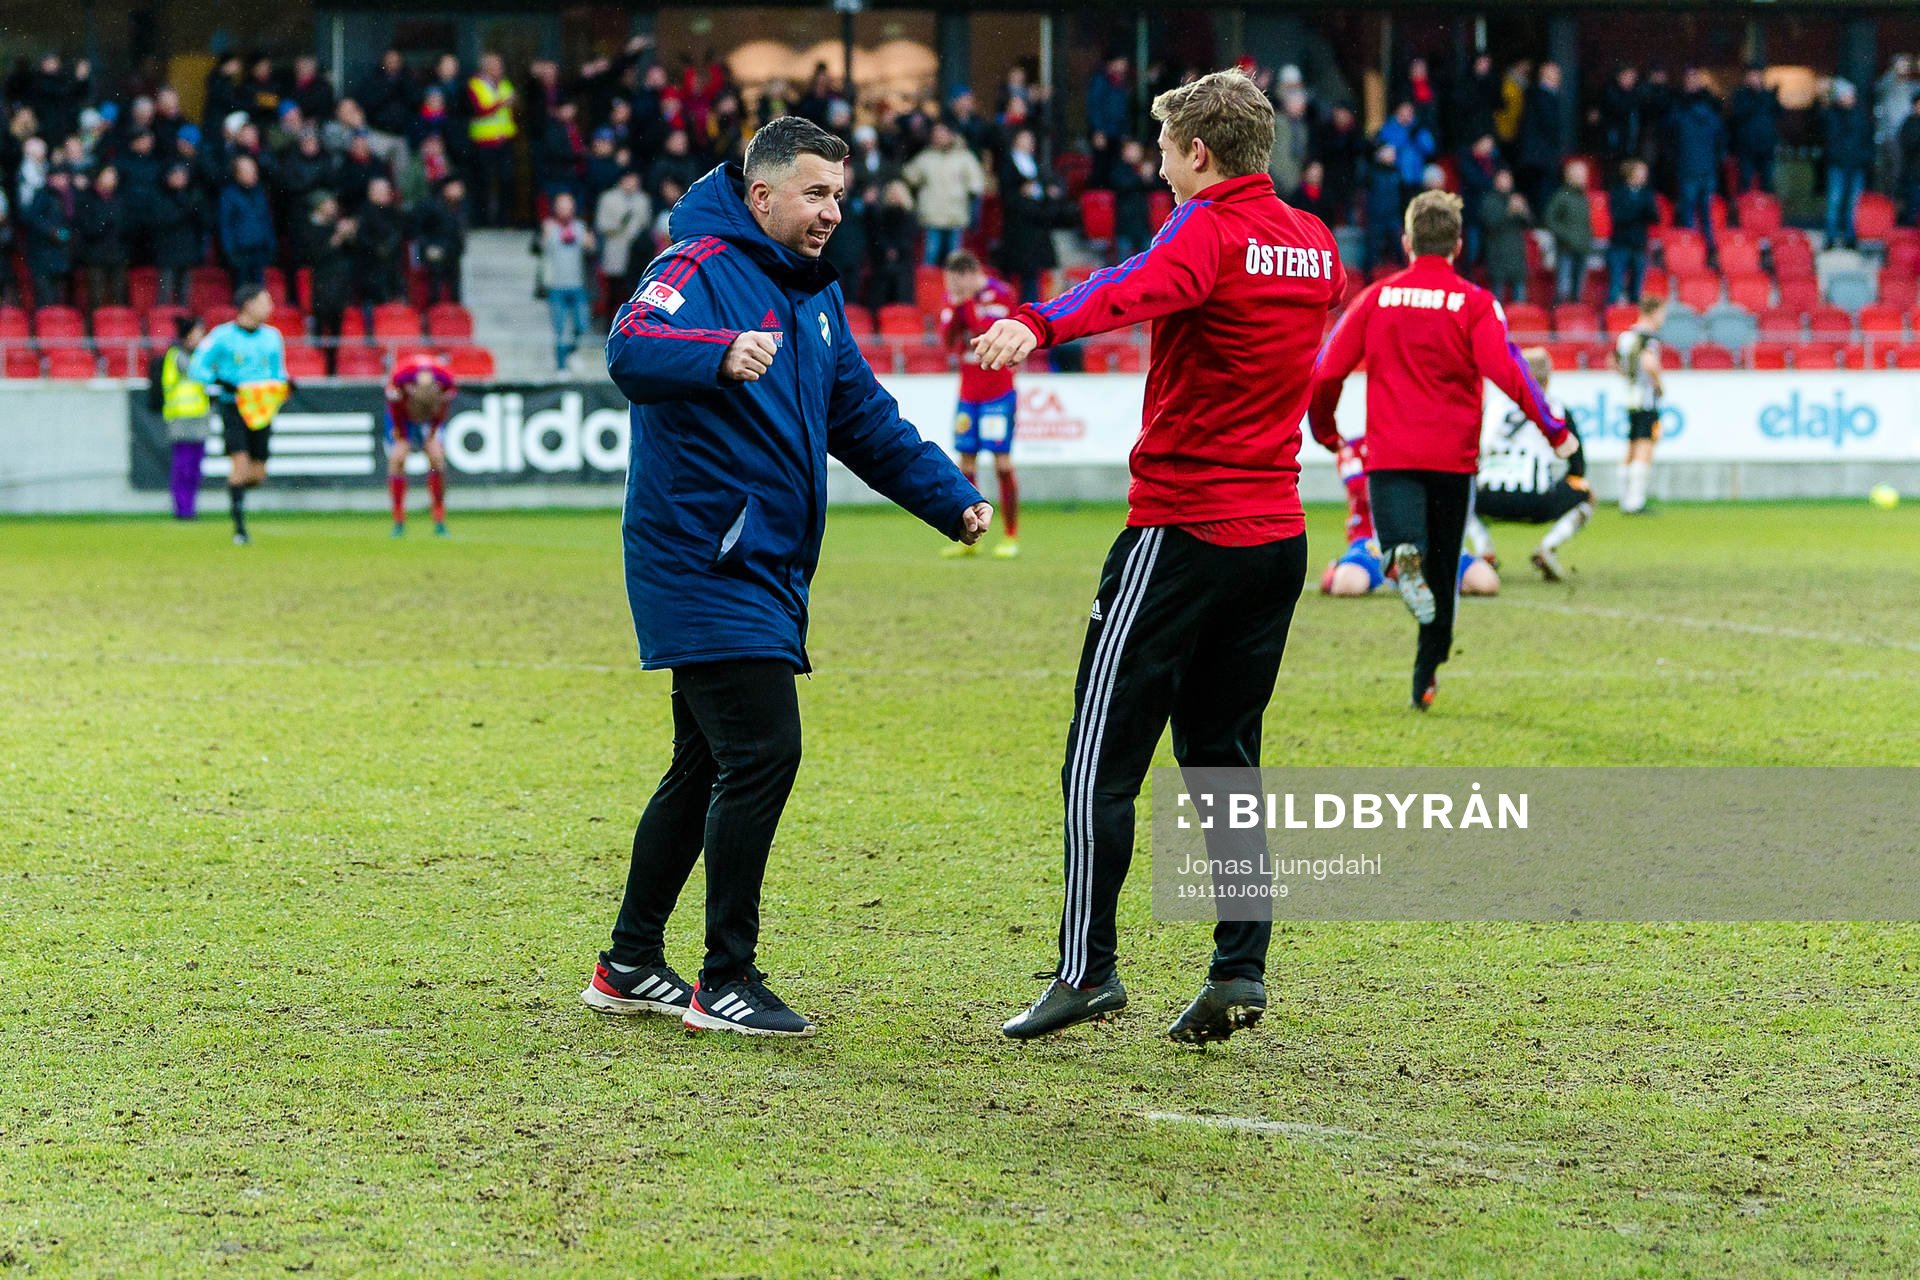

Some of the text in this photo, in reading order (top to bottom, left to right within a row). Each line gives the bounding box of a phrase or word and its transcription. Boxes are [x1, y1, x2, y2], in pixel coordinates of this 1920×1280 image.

[1245, 238, 1333, 280] ÖSTERS IF
[1377, 286, 1465, 312] ÖSTERS IF
[1571, 388, 1686, 440] elao
[1758, 390, 1879, 448] elajo
